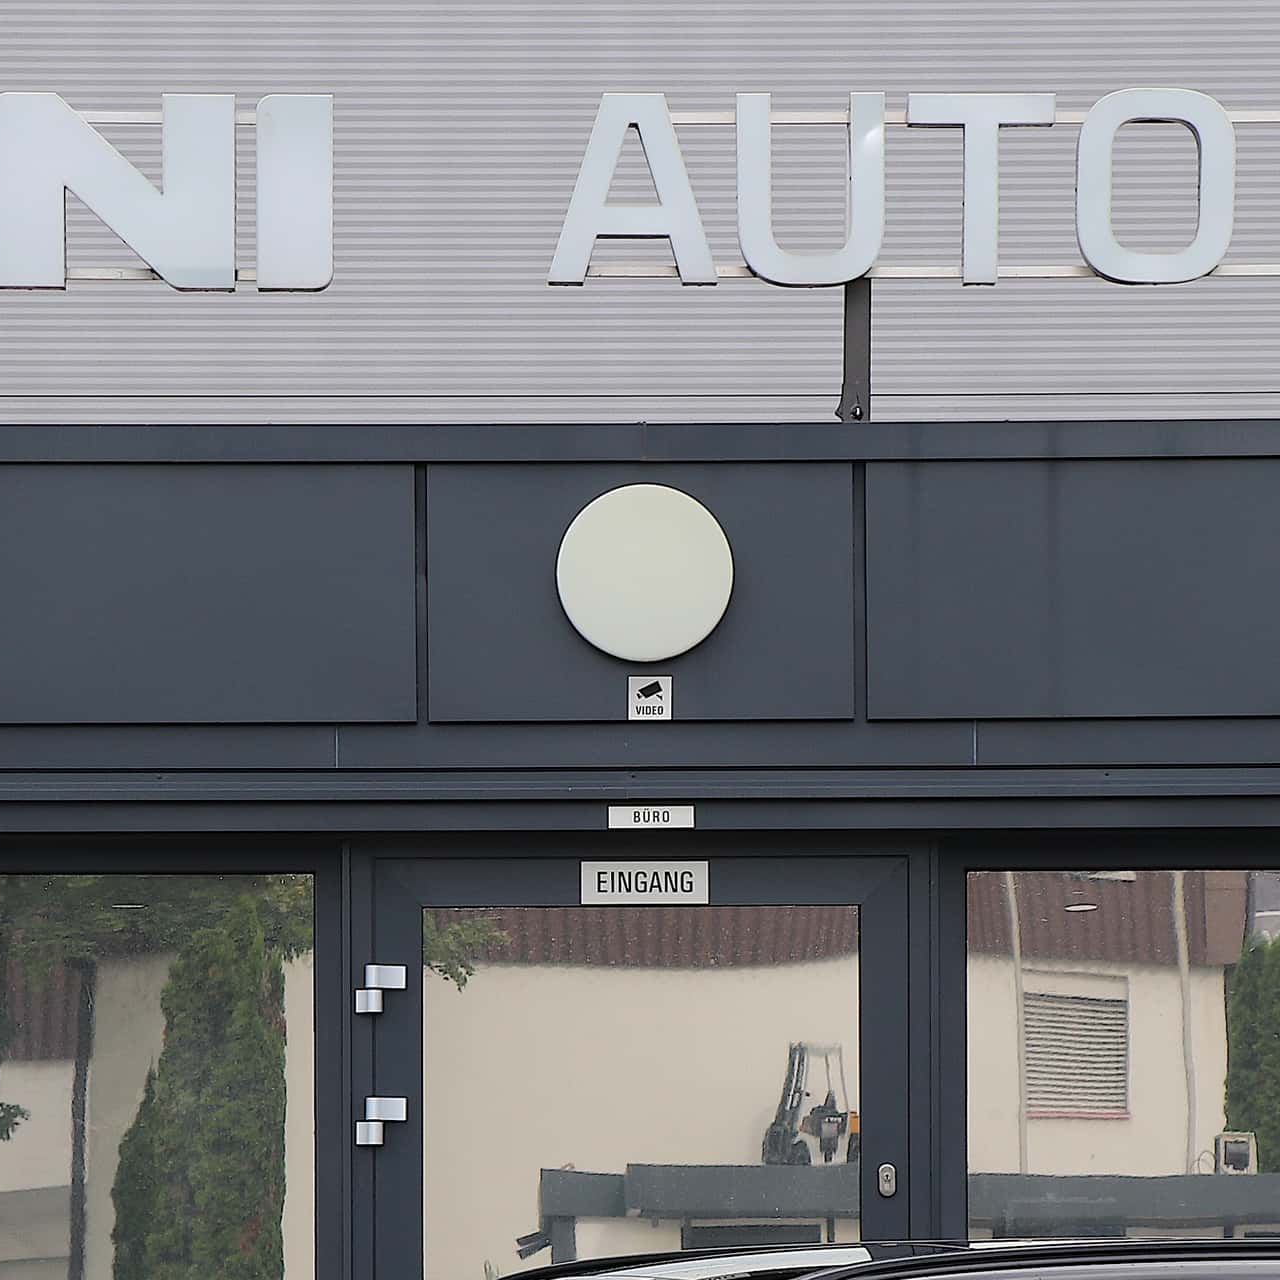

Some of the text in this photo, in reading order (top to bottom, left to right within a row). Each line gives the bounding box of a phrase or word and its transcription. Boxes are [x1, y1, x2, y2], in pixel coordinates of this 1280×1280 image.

[547, 87, 1236, 288] AUTO
[635, 705, 664, 716] VIDEO
[632, 808, 671, 823] BÜRO
[596, 871, 694, 893] EINGANG
